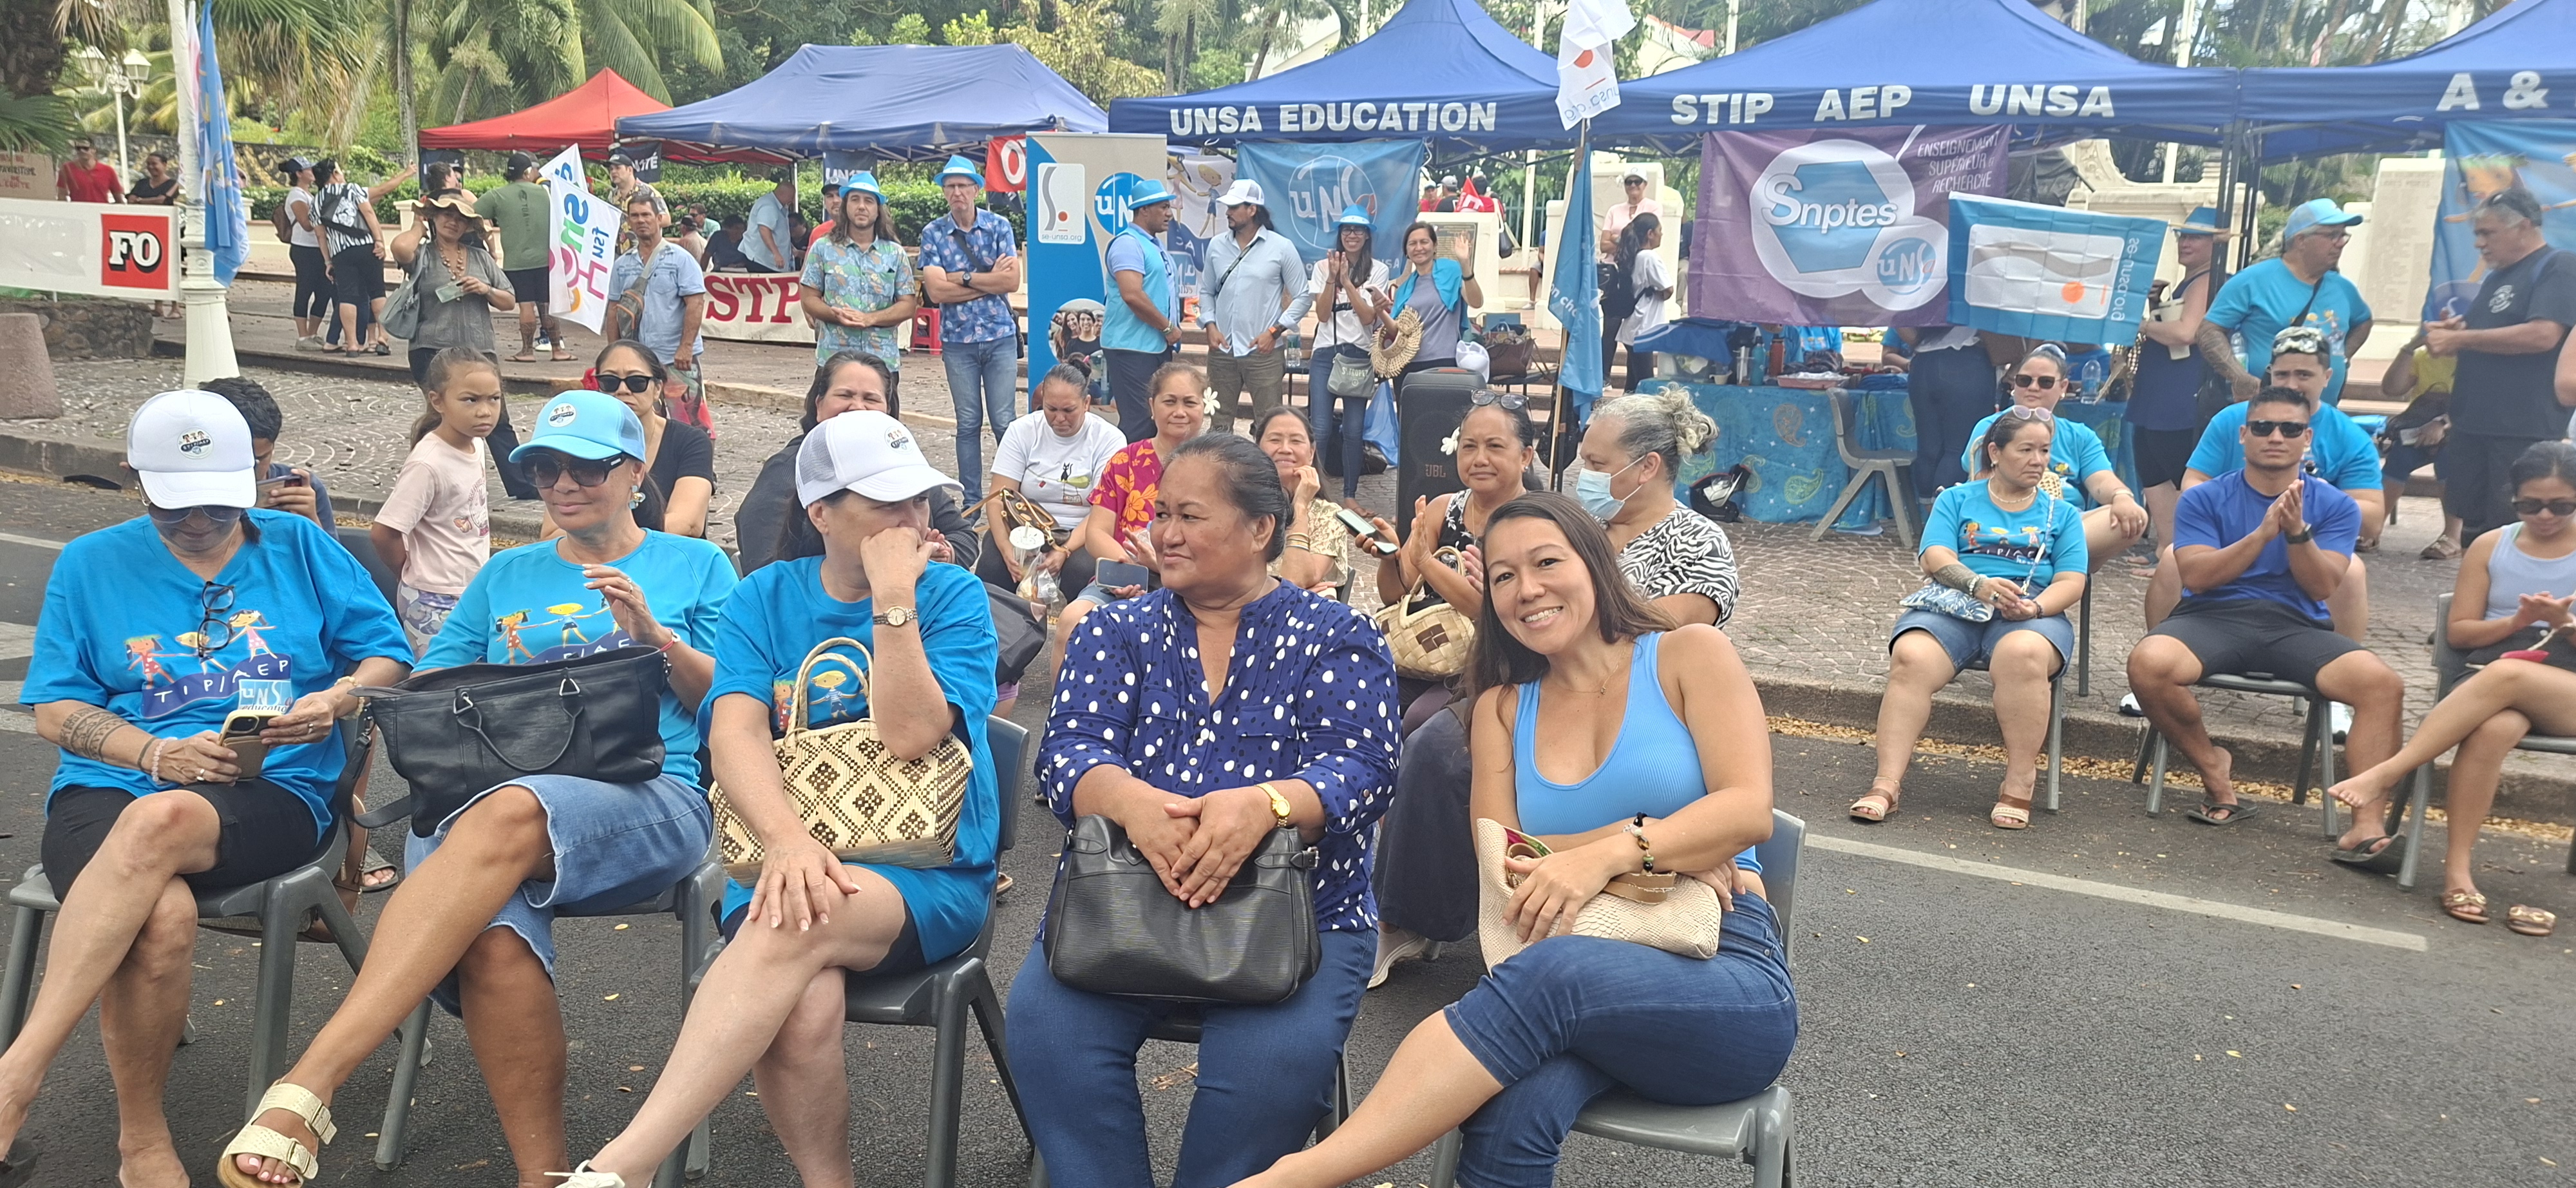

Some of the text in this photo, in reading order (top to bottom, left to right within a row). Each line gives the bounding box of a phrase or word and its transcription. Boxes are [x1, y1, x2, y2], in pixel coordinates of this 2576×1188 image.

[1671, 84, 2116, 124] STIP AEP UNSA
[2503, 71, 2549, 110] &
[1170, 102, 1497, 136] UNSA EDUCATION
[1917, 129, 2000, 158] ENSEIGNEMENT
[1928, 153, 1987, 177] SUPÉRIEUR
[1931, 171, 1993, 194] RECHERCHE
[1761, 173, 1898, 235] Snptes
[108, 229, 163, 274] FO
[1041, 233, 1083, 242] se-unsa.org
[1425, 464, 1446, 478] JBL
